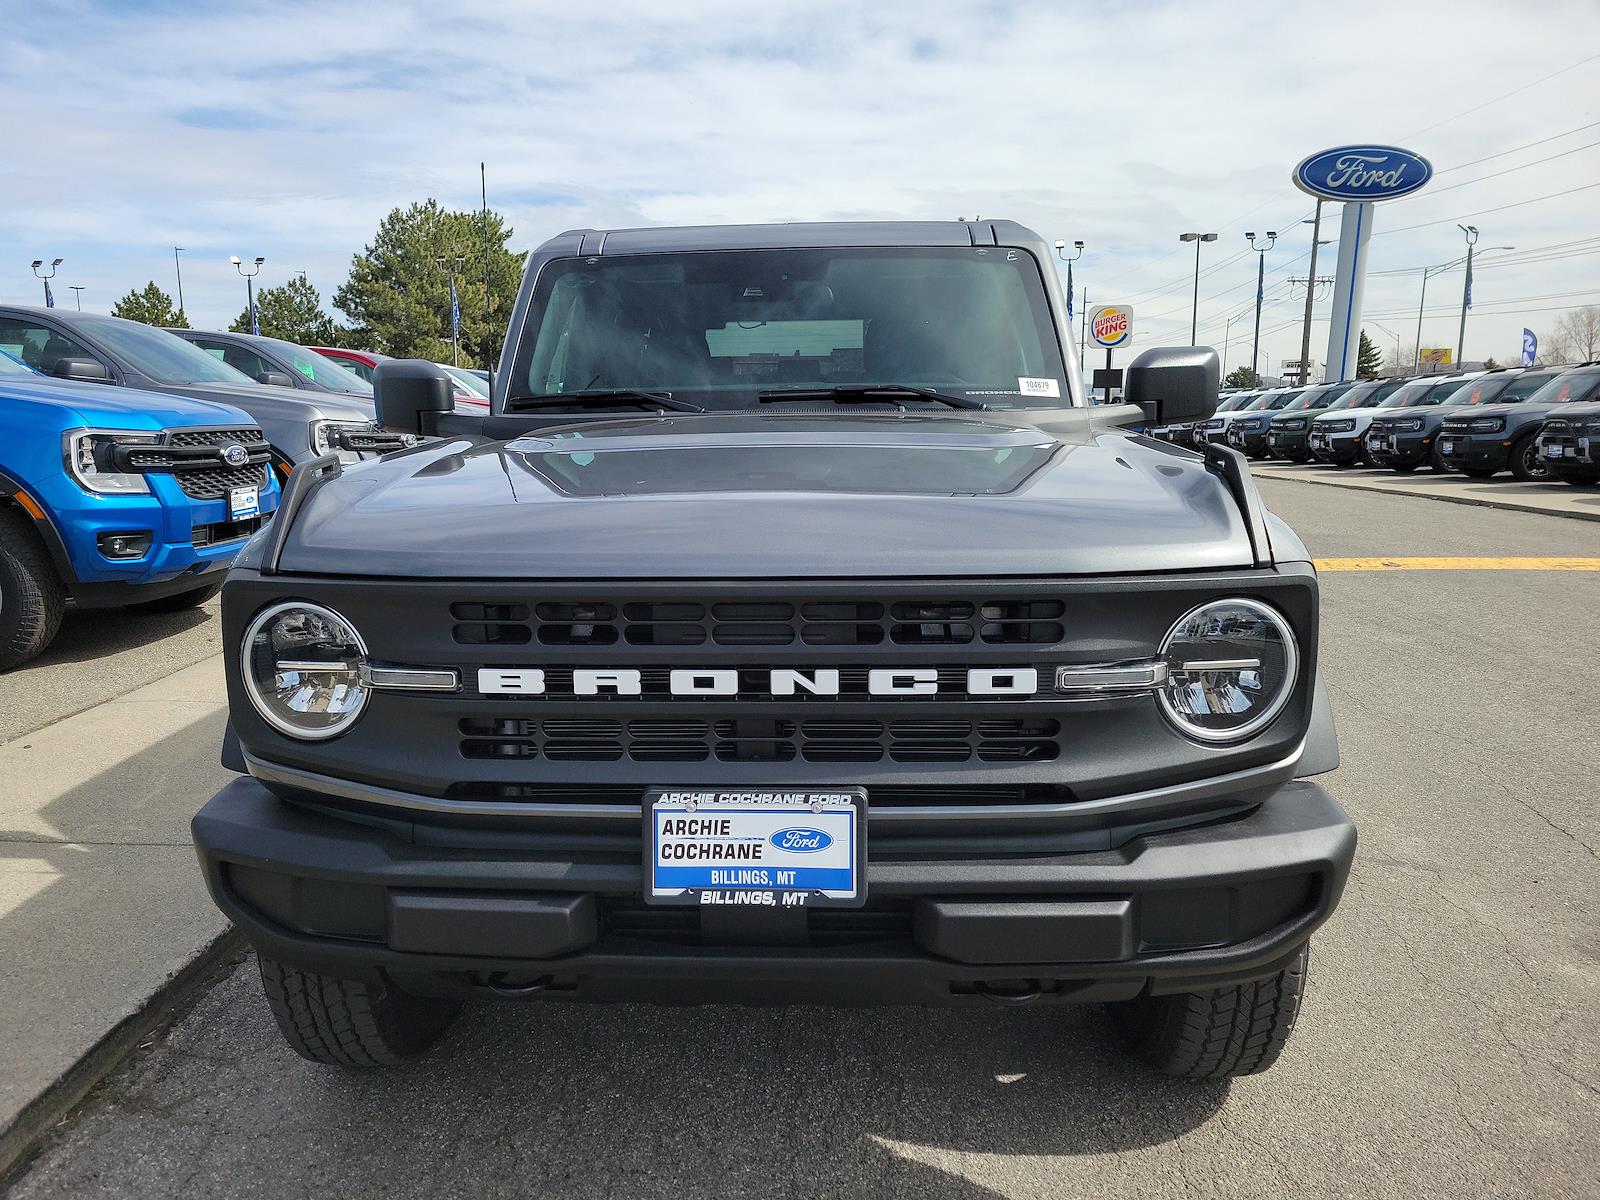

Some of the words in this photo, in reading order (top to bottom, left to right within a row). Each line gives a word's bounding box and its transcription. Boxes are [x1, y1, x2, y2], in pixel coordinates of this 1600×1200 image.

[1326, 155, 1407, 188] Ford
[1095, 313, 1126, 328] BURGER
[1096, 320, 1127, 338] KING
[477, 668, 1038, 696] BRONCO
[658, 793, 715, 804] ARCHIE
[718, 794, 805, 805] COCHRANE
[808, 795, 852, 806] FORD
[662, 819, 731, 836] ARCHIE
[782, 830, 820, 849] Ford
[661, 843, 762, 860] COCHRANE
[711, 869, 773, 887] BILLINGS,
[777, 871, 796, 886] MT
[700, 890, 776, 906] BILLINGS,
[782, 892, 808, 906] MT
